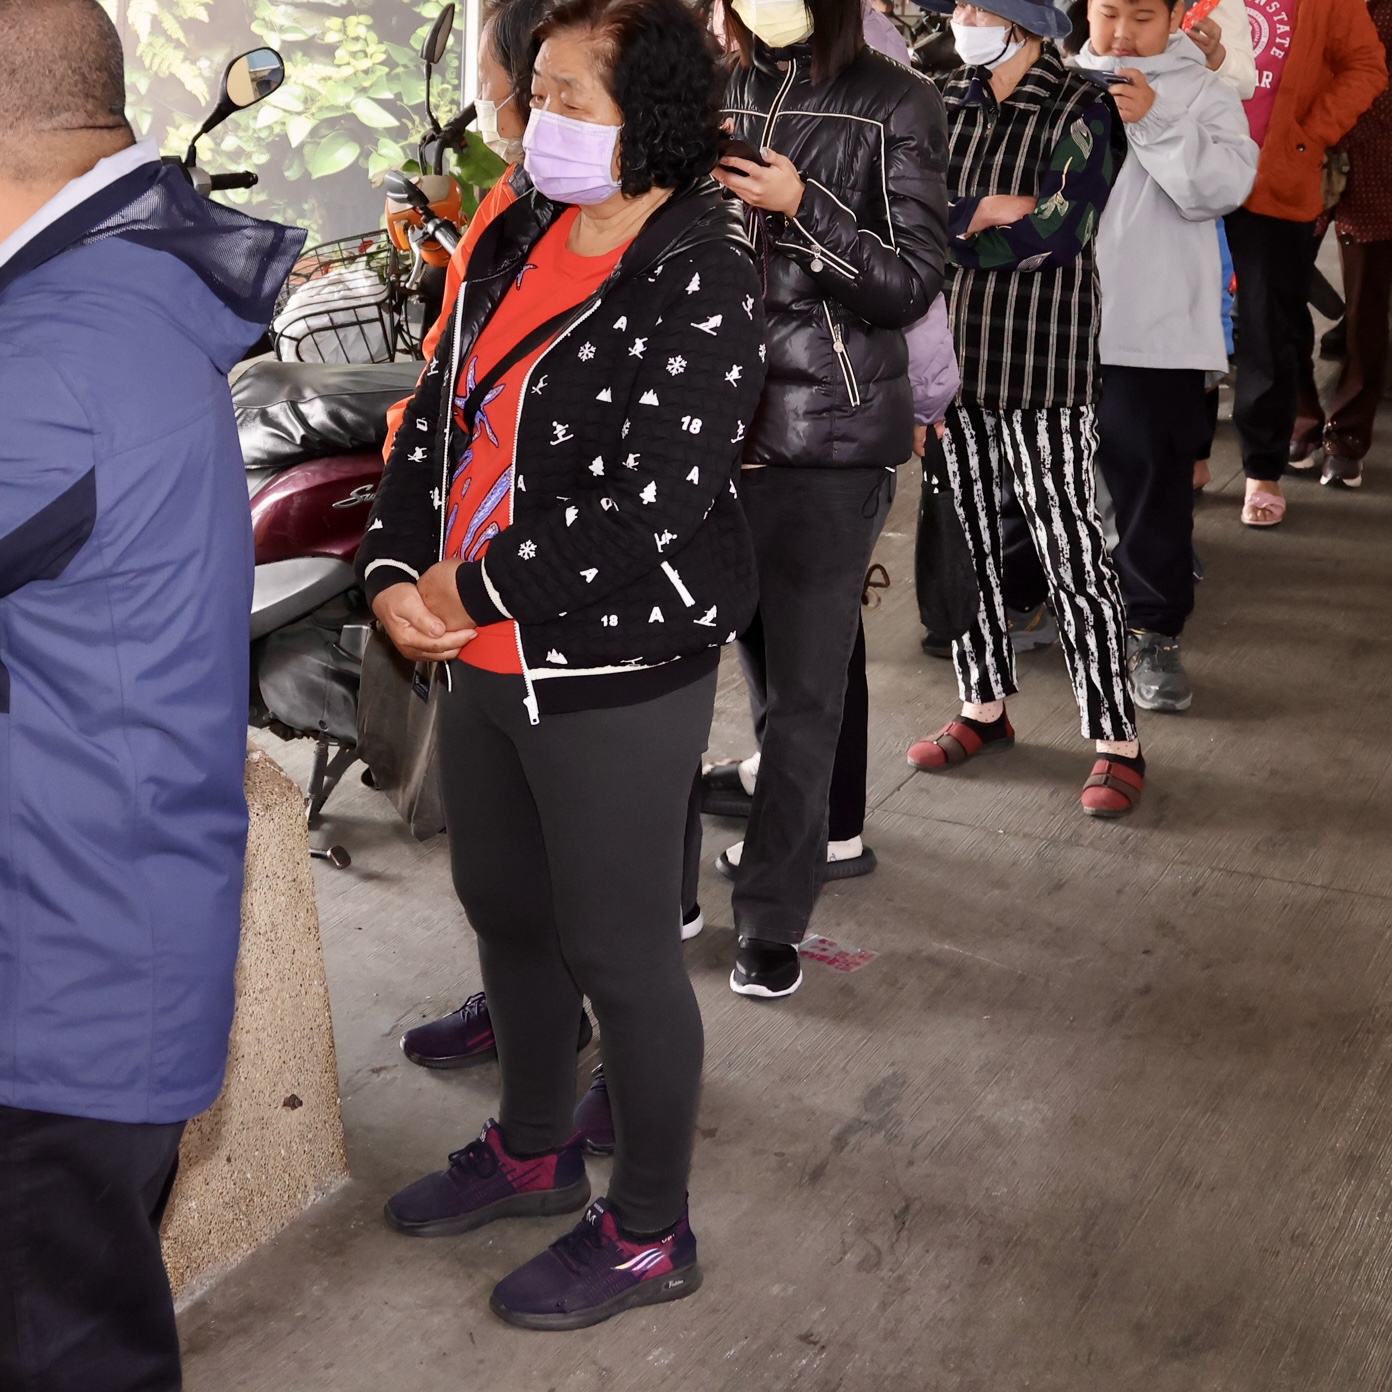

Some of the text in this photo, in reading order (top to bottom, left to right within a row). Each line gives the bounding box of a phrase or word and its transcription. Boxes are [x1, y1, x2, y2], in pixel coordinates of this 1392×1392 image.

[681, 415, 703, 435] 18
[601, 614, 619, 627] 18
[648, 606, 665, 624] A
